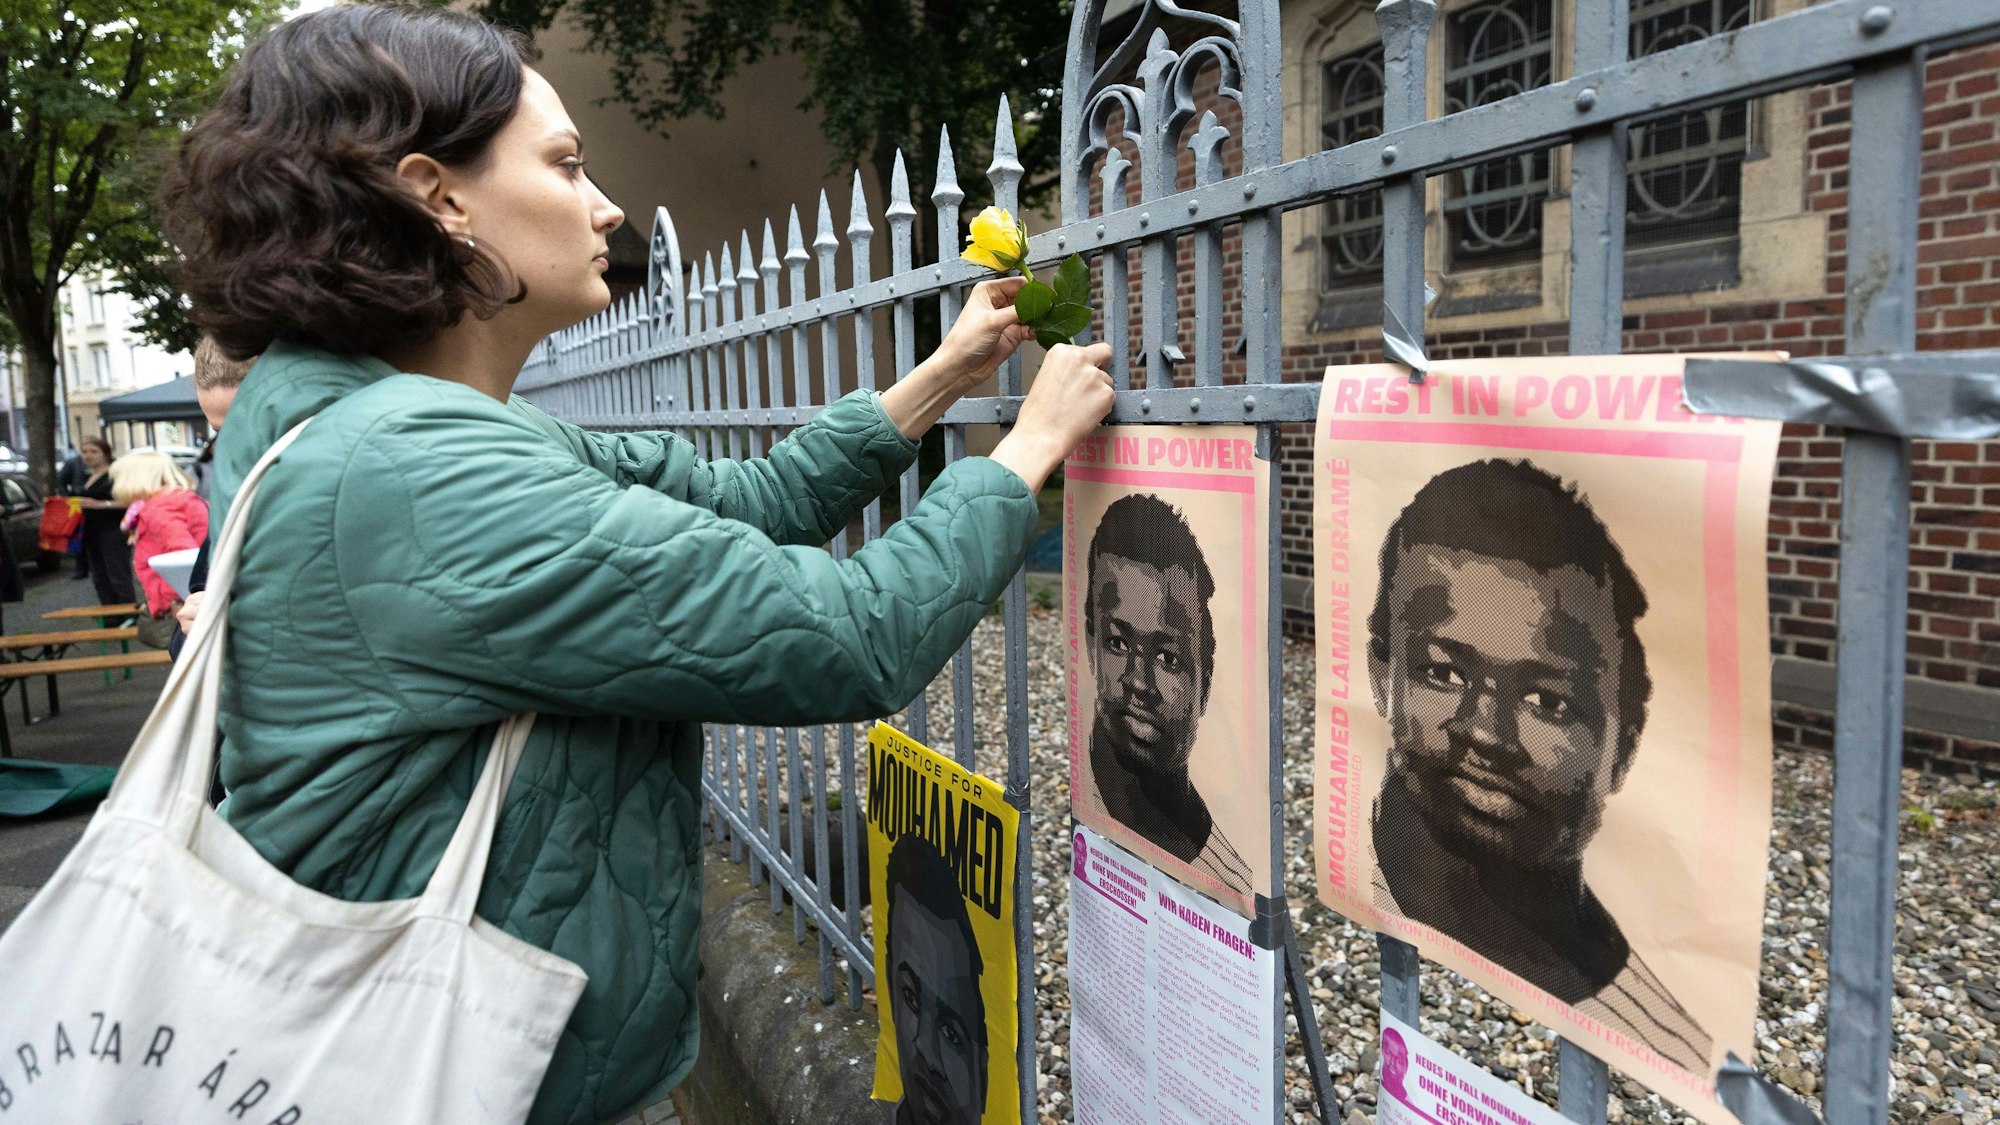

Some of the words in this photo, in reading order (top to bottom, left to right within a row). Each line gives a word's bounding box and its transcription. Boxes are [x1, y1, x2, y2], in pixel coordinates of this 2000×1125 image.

[1334, 376, 1439, 415] REST
[1451, 375, 1499, 417] IN
[1513, 375, 1744, 424] POWE
[1114, 437, 1139, 465] IN
[1147, 437, 1253, 471] POWER
[1325, 458, 1350, 574] DRAMÉ
[1069, 576, 1079, 664] LAMINE
[1331, 579, 1350, 699] LAMINE
[1070, 668, 1080, 801] MOUHAMED
[887, 736, 942, 778] JUSTICE
[952, 773, 983, 800] FOR
[1329, 706, 1350, 889] MOUHAMED
[868, 742, 1004, 920] MOUHAMED
[1090, 846, 1104, 861] NEUES
[1110, 858, 1120, 870] FALL
[1120, 863, 1149, 888] MOUHAMED:
[1092, 860, 1106, 878] OHNE
[1106, 869, 1146, 902] VORWARNUNG
[1177, 860, 1203, 880] POLIZEI
[1099, 877, 1137, 909] ERSCHOSSEN!
[1158, 891, 1178, 916] WIR
[1179, 903, 1211, 936] HABEN
[1212, 923, 1256, 962] FRAGEN:
[1158, 934, 1183, 952] Mouhamed
[1216, 952, 1231, 964] Polizei
[1194, 986, 1209, 1000] Polizei
[1331, 888, 1345, 900] AM
[1395, 917, 1422, 938] VON
[1426, 930, 1450, 951] DER
[1453, 941, 1543, 1002] DORTMUNDER
[1545, 995, 1601, 1037] POLIZEI
[1606, 1030, 1714, 1100] ERSCHOSSEN
[1207, 1035, 1237, 1058] Mouhamed
[1219, 1012, 1241, 1029] Deutsch
[1246, 1028, 1259, 1041] noch
[1415, 1053, 1443, 1078] NEUES
[1445, 1070, 1457, 1087] IM
[1459, 1080, 1479, 1100] FALL
[1419, 1075, 1448, 1103] OHNE
